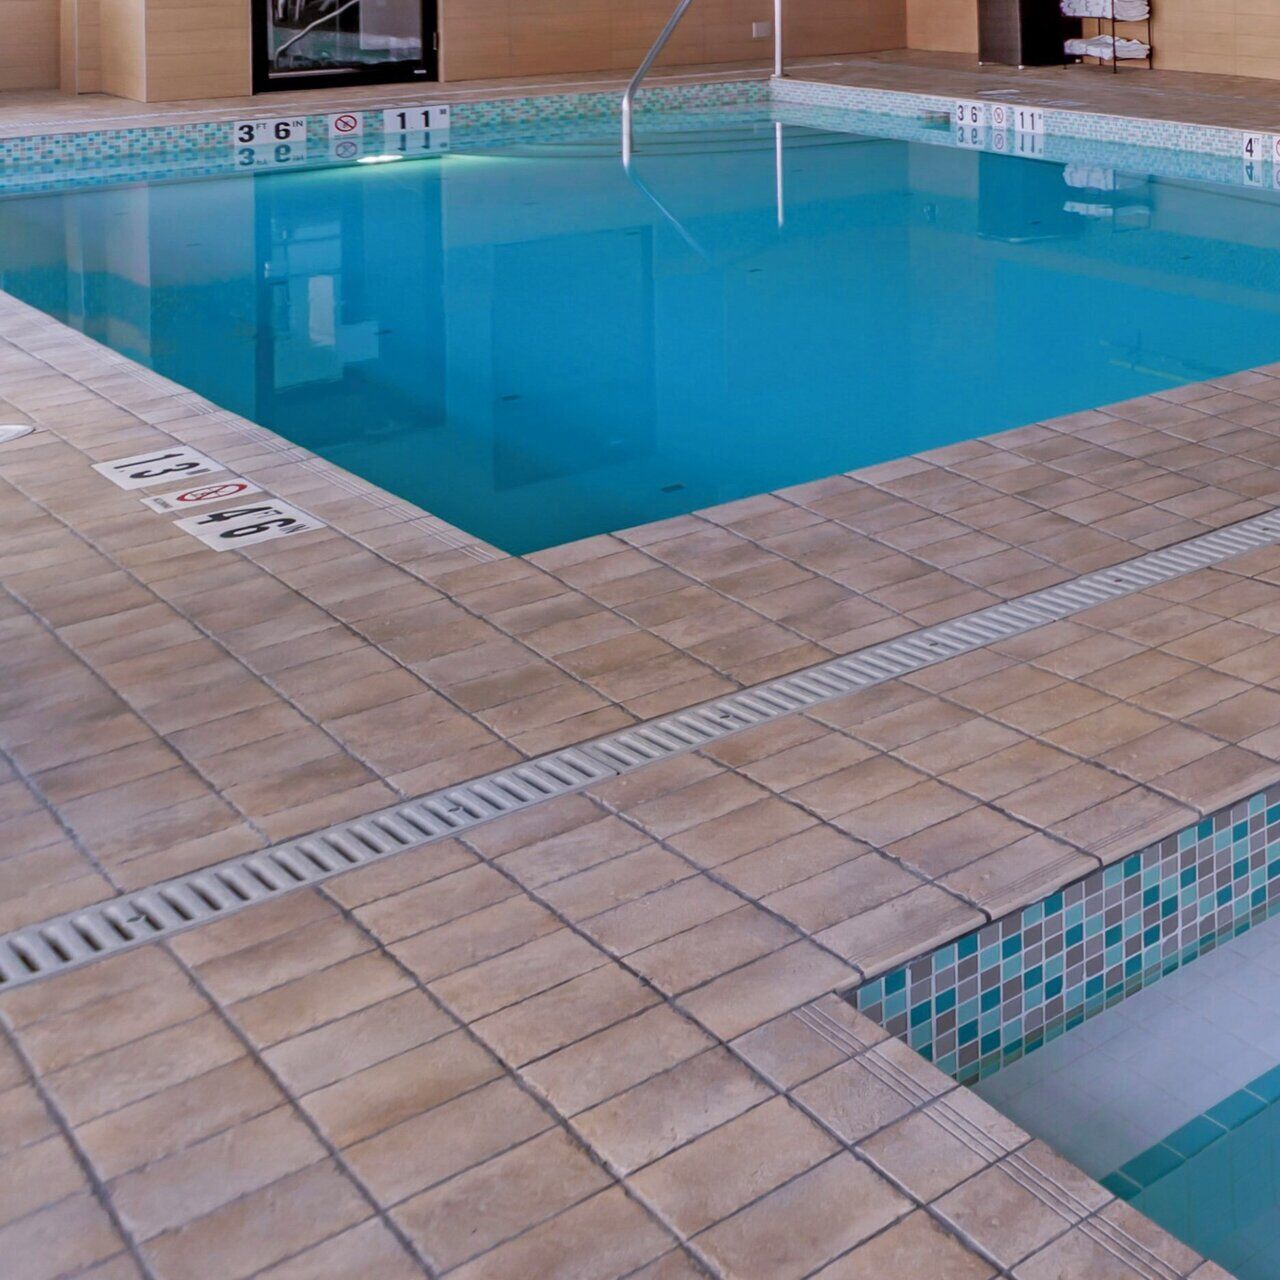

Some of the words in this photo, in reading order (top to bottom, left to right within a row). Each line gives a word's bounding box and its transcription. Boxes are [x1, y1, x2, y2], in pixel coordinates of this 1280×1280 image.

[958, 105, 964, 121] 3
[971, 106, 978, 123] 6
[238, 124, 255, 143] 3
[274, 121, 291, 140] 6
[292, 120, 303, 128] IN
[1245, 138, 1254, 157] 4
[198, 506, 272, 525] 4
[219, 517, 297, 539] 6
